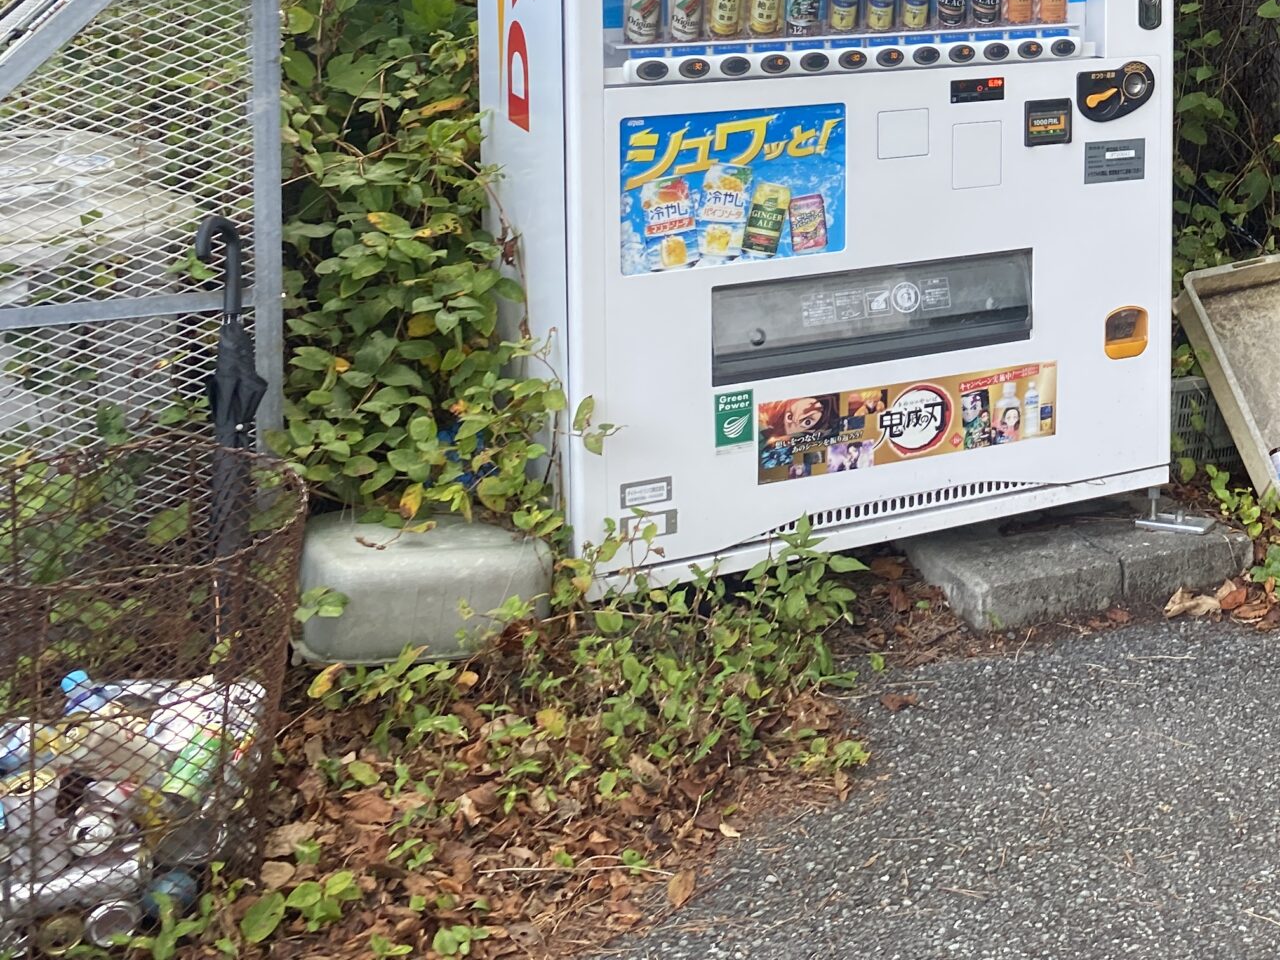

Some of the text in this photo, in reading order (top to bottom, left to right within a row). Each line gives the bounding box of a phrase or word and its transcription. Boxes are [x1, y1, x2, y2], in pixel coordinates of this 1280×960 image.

[1033, 118, 1059, 126] 1000円札
[625, 115, 844, 191] シュワッと!
[708, 191, 744, 207] 冷やし
[649, 204, 688, 220] 冷やし
[752, 209, 783, 221] GINGER
[756, 220, 774, 228] ALE
[720, 394, 748, 403] Green
[719, 401, 750, 411] Power
[873, 401, 946, 449] 鬼滅の刃
